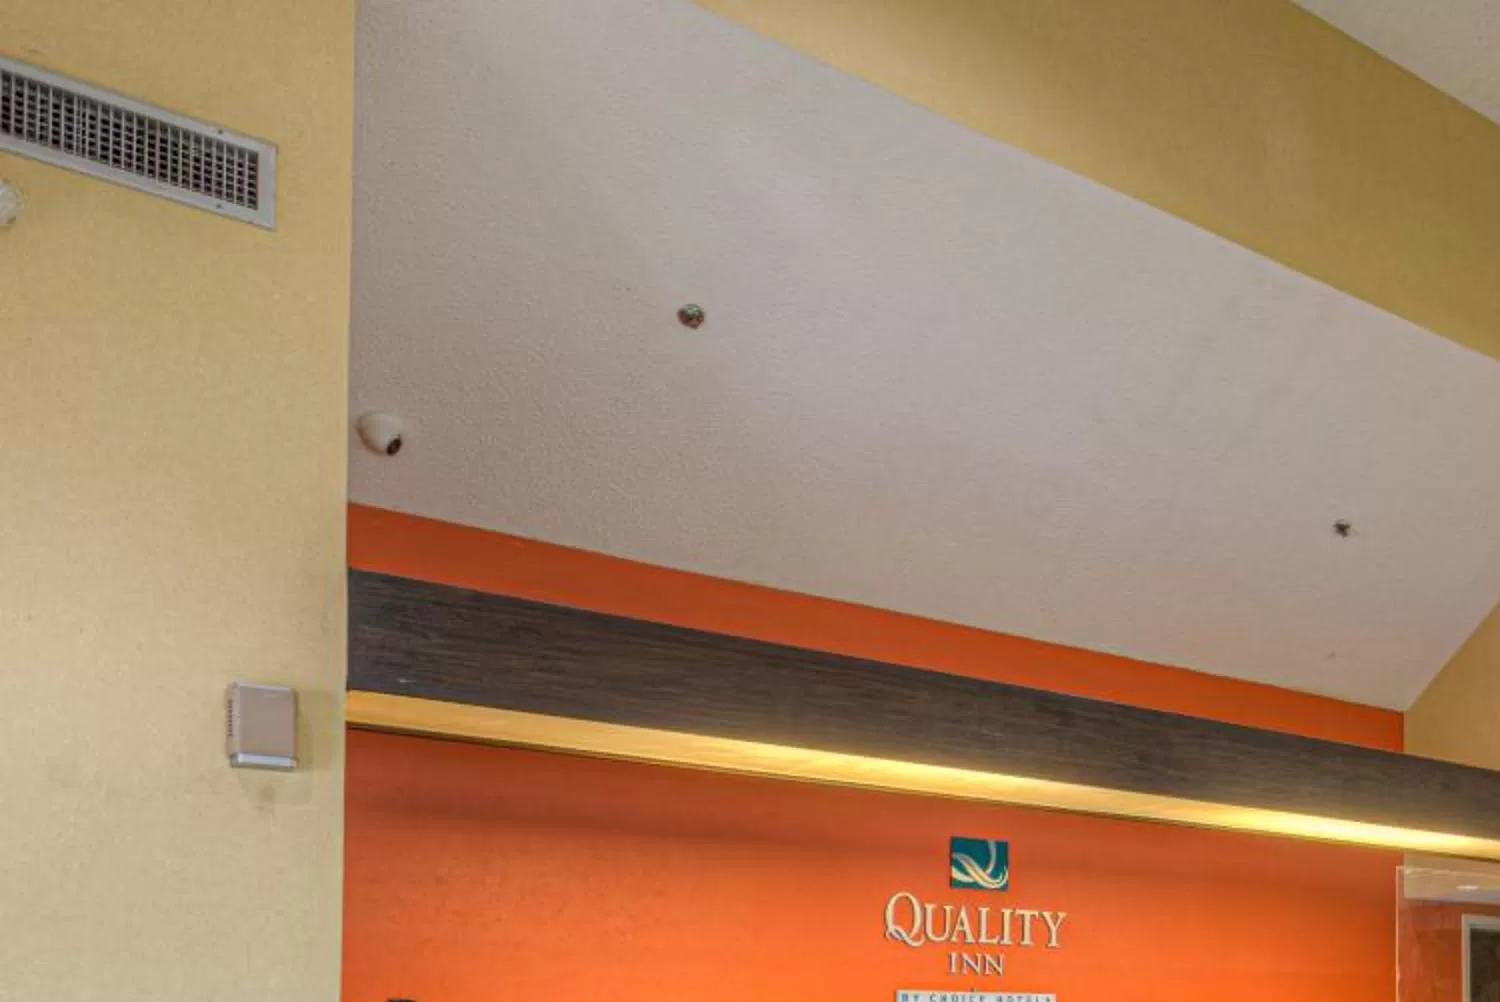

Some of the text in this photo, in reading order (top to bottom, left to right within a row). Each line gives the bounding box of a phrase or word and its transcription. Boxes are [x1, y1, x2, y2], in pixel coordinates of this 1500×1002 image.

[884, 892, 1067, 947] QUALITY
[950, 951, 1005, 975] INN
[900, 992, 920, 1002] BY
